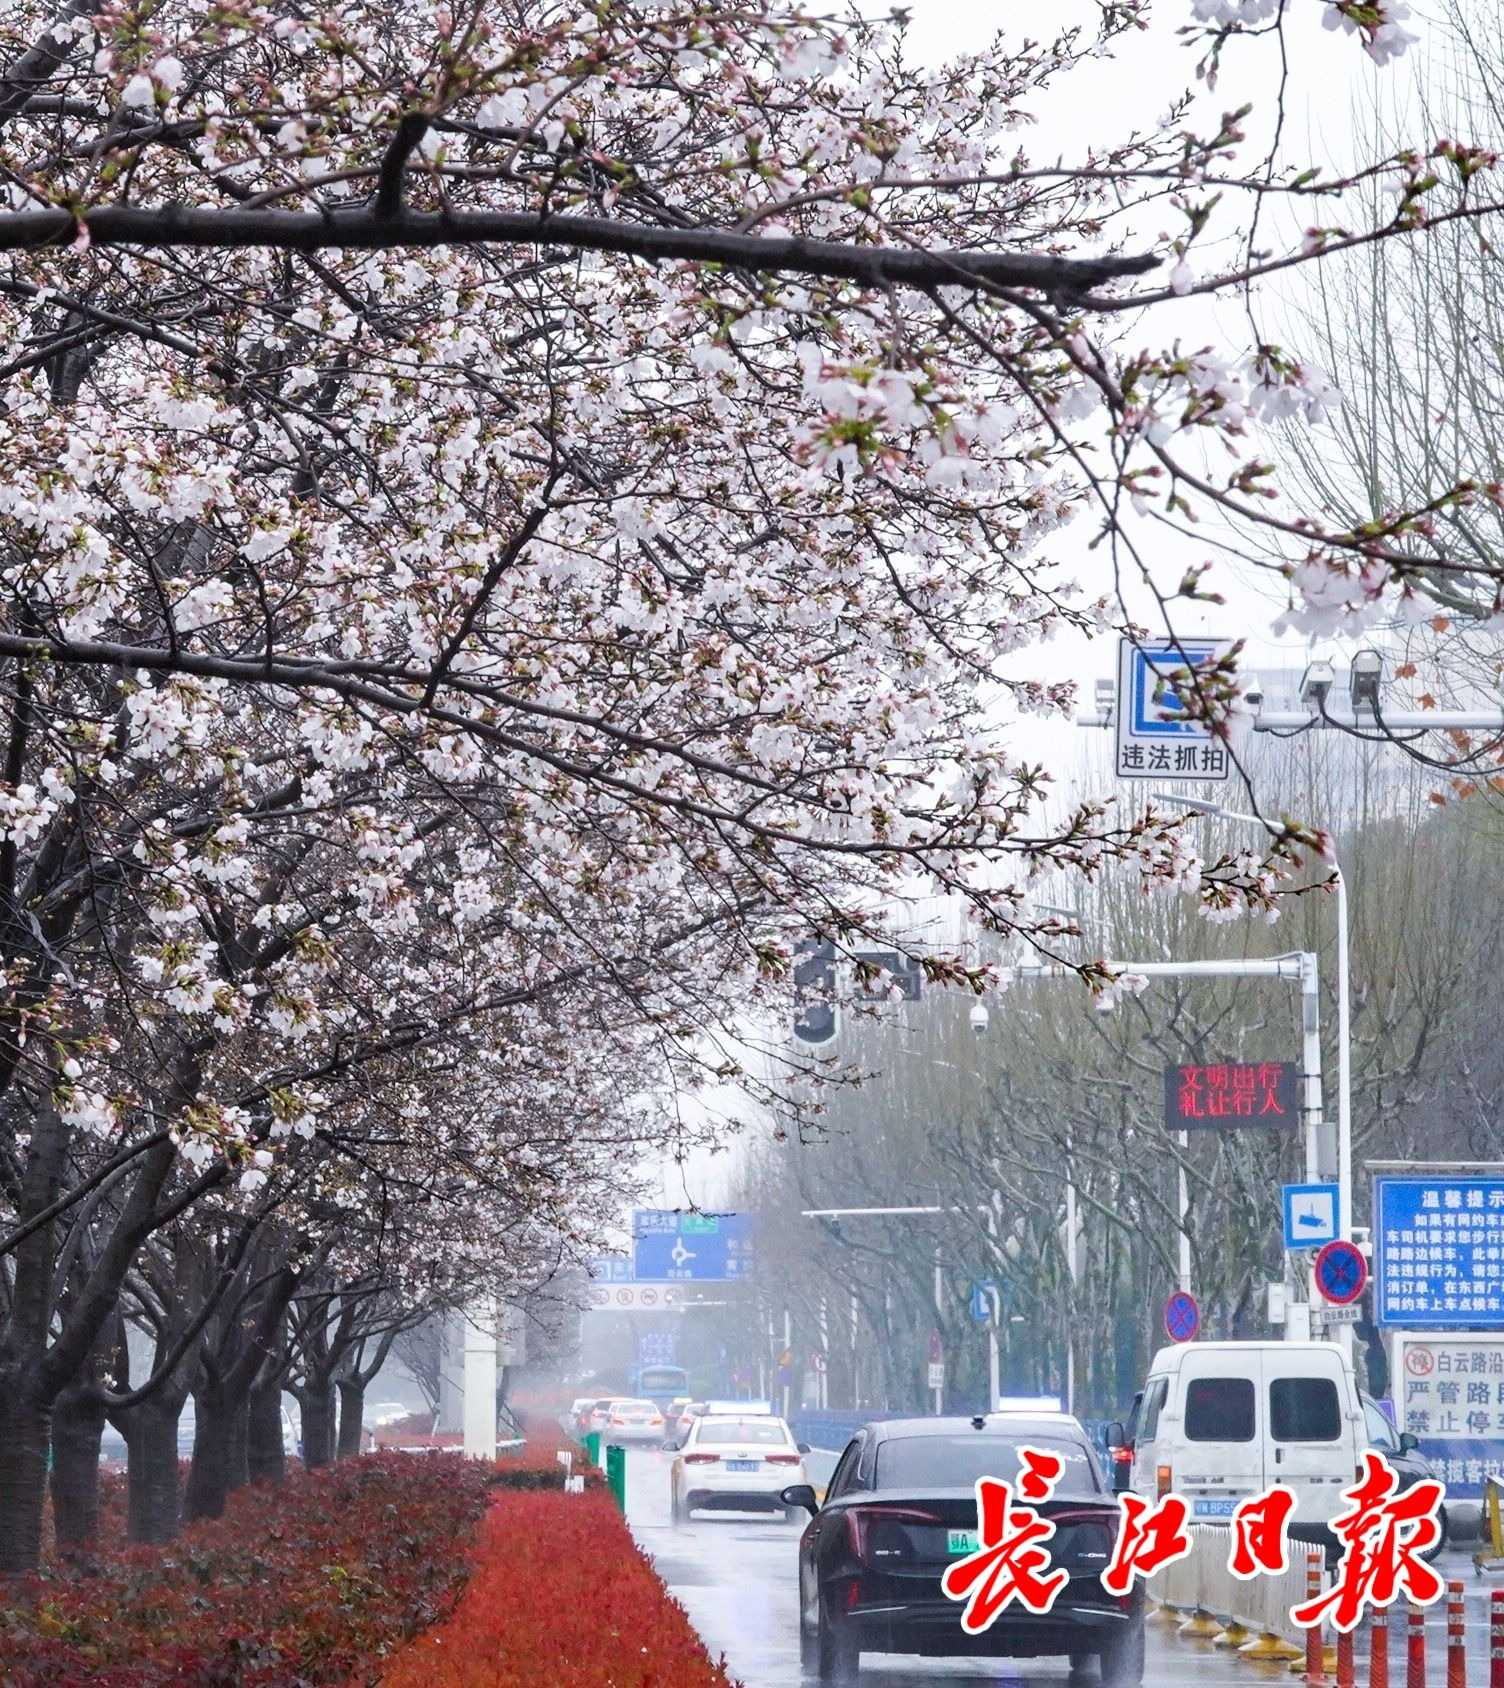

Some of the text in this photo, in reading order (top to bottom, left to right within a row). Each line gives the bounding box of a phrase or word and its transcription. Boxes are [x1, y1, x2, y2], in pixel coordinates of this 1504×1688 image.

[1121, 743, 1225, 772] 违法抓拍
[1179, 1063, 1282, 1090] 文明出行
[1180, 1089, 1285, 1118] 礼让行人
[1422, 1190, 1504, 1208] 温馨提示
[1414, 1213, 1504, 1227] 如果有网约车
[1387, 1230, 1504, 1243] 车司机要求您步行
[1387, 1264, 1504, 1277] 法违规行为，请您
[1387, 1281, 1504, 1294] 消订单，在东西广
